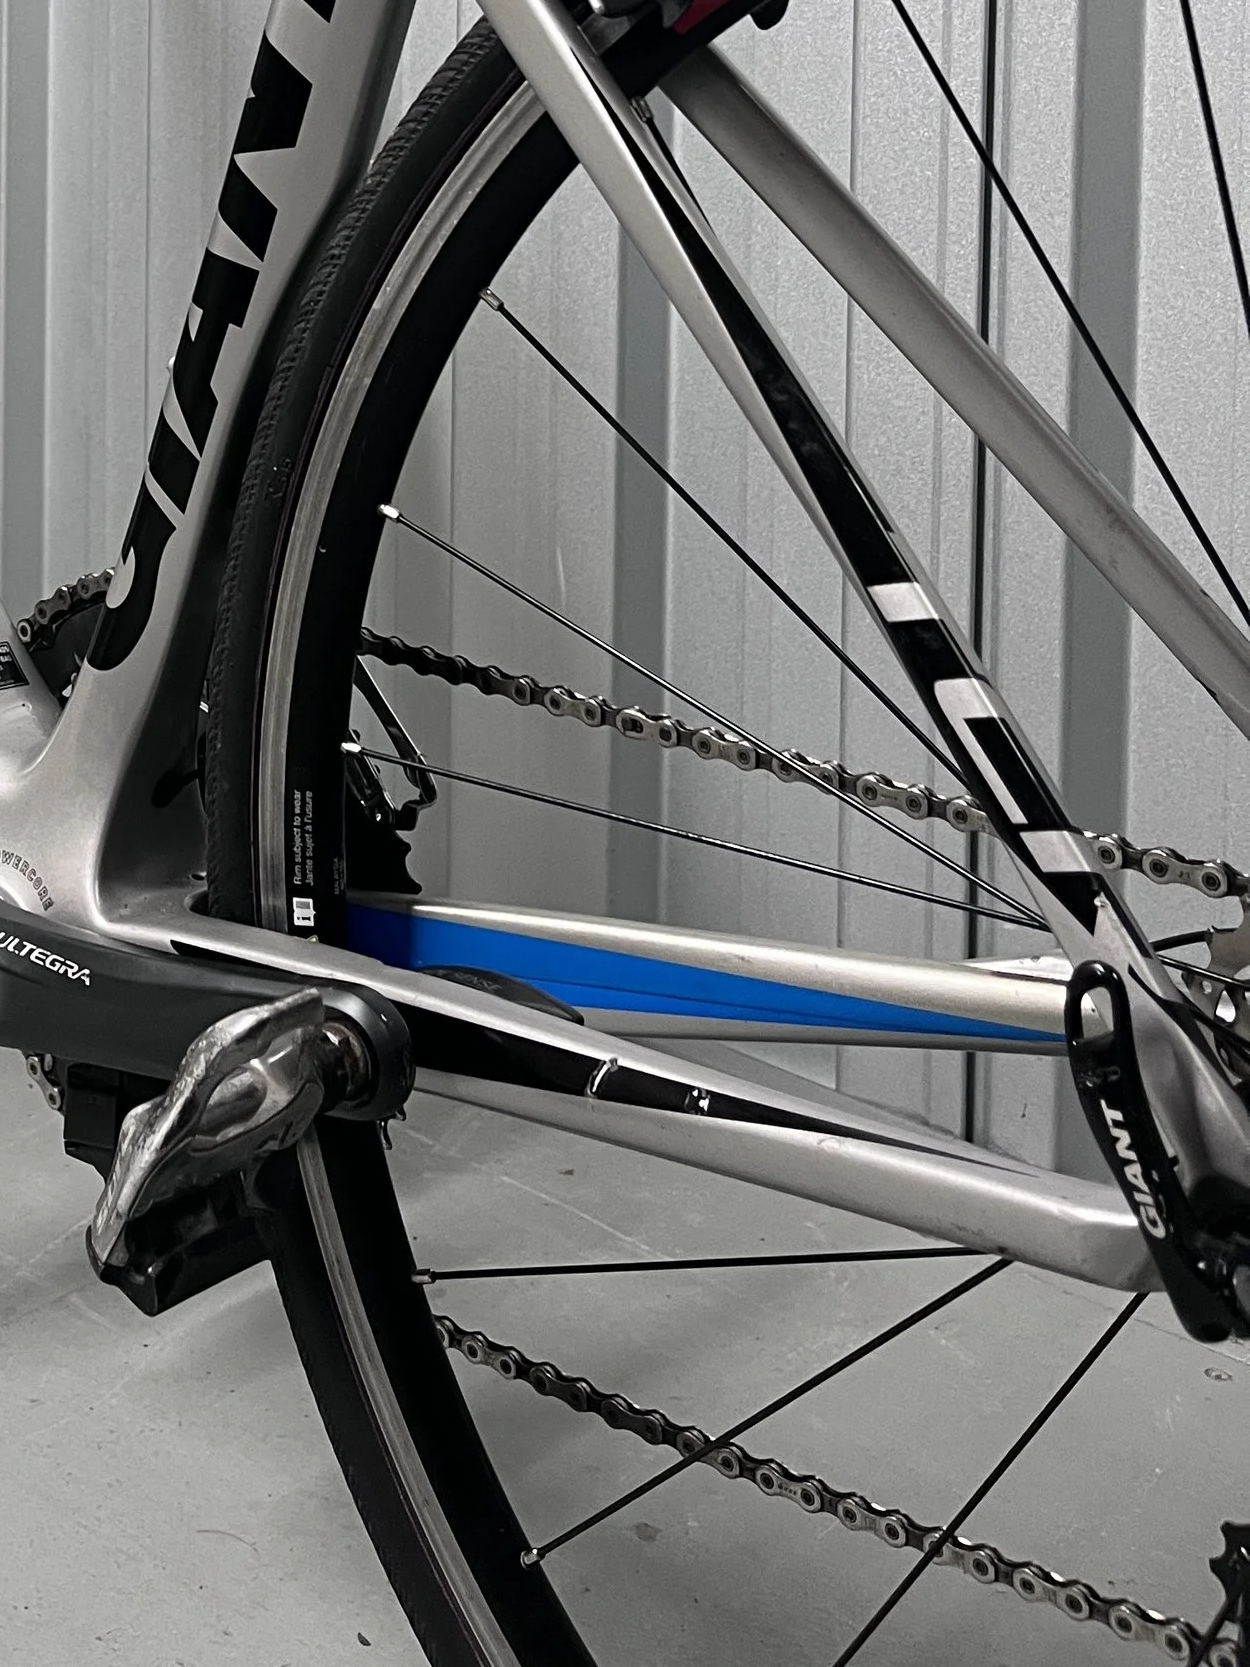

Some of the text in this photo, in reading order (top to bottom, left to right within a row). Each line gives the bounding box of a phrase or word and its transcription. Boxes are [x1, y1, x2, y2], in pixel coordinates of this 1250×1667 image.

[293, 789, 303, 885] Rim subject to wear
[1100, 1098, 1167, 1239] GIANT
